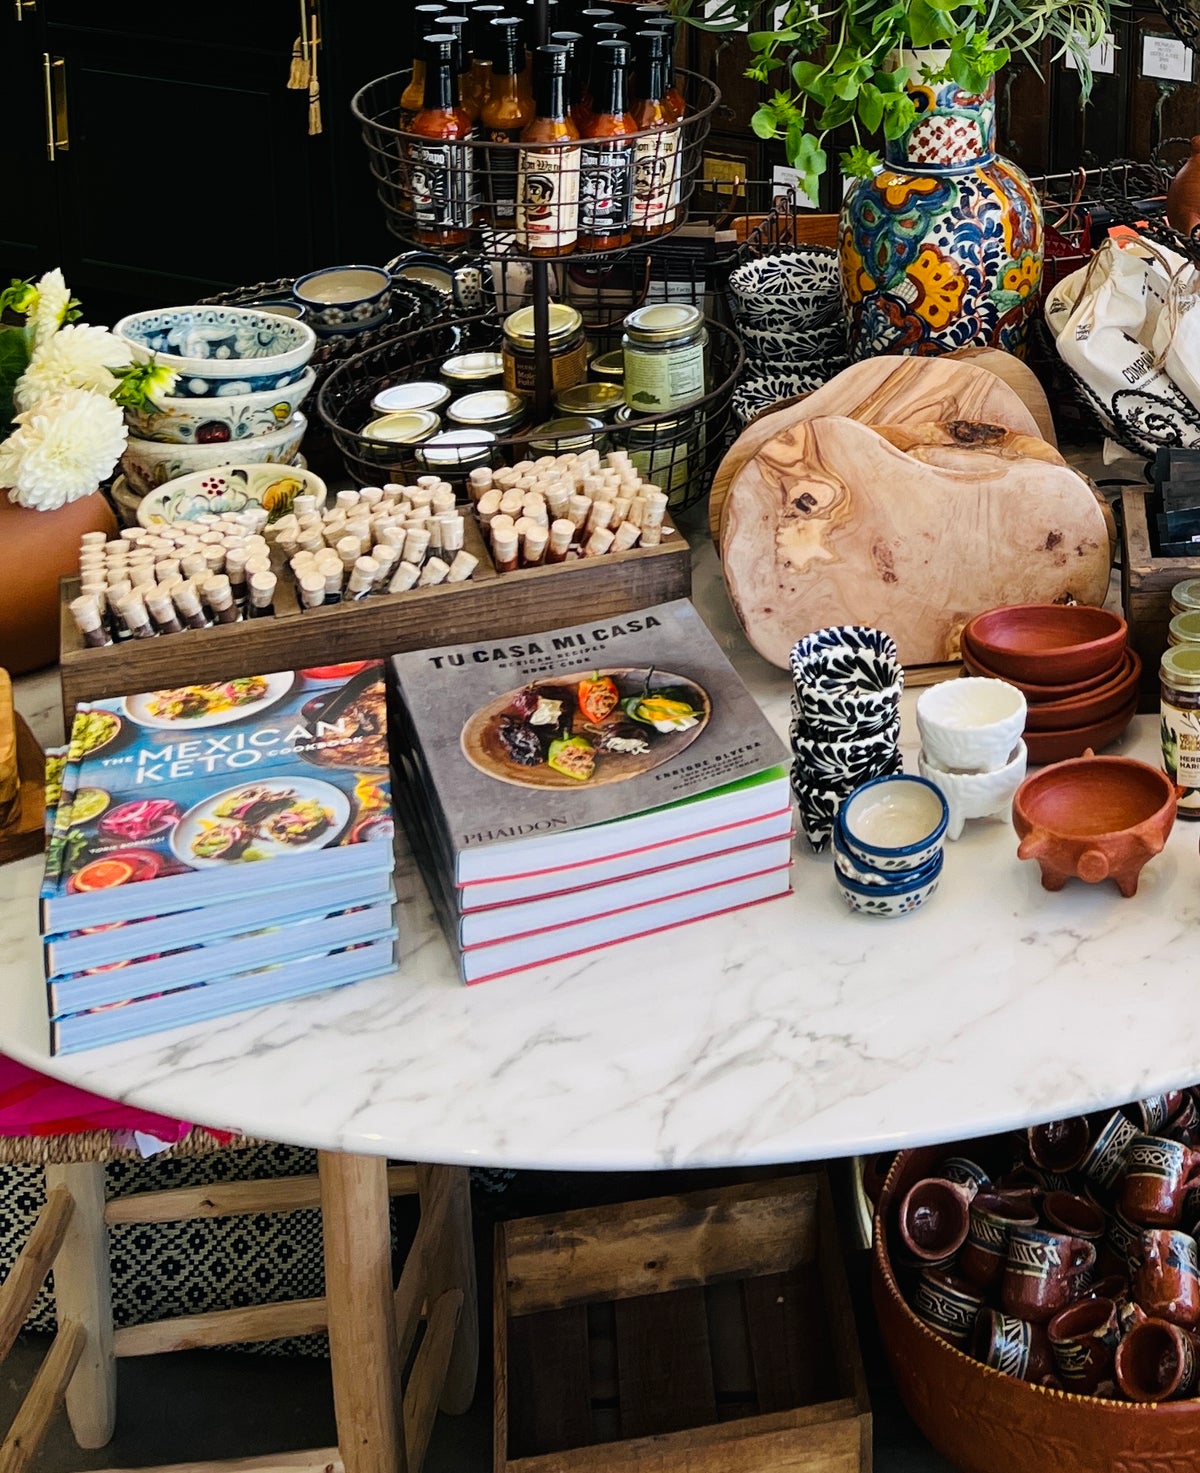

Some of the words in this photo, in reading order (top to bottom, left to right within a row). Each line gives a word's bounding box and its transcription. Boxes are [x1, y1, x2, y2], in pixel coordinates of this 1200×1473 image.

[1121, 350, 1155, 384] COMPAÑ
[429, 654, 464, 669] TU
[472, 642, 544, 663] CASA
[551, 633, 587, 651] MI
[592, 615, 662, 641] CASA
[498, 656, 553, 669] MEXICAN
[556, 644, 607, 660] RECIPES
[560, 657, 591, 668] COOK
[101, 755, 135, 767] THE
[137, 718, 348, 766] MEXICAN
[135, 749, 262, 785] KETO
[263, 736, 364, 758] COOKBOOK
[655, 760, 710, 781] ENRIQUE
[715, 742, 761, 762] OLVERA
[463, 815, 569, 846] PHAIDON
